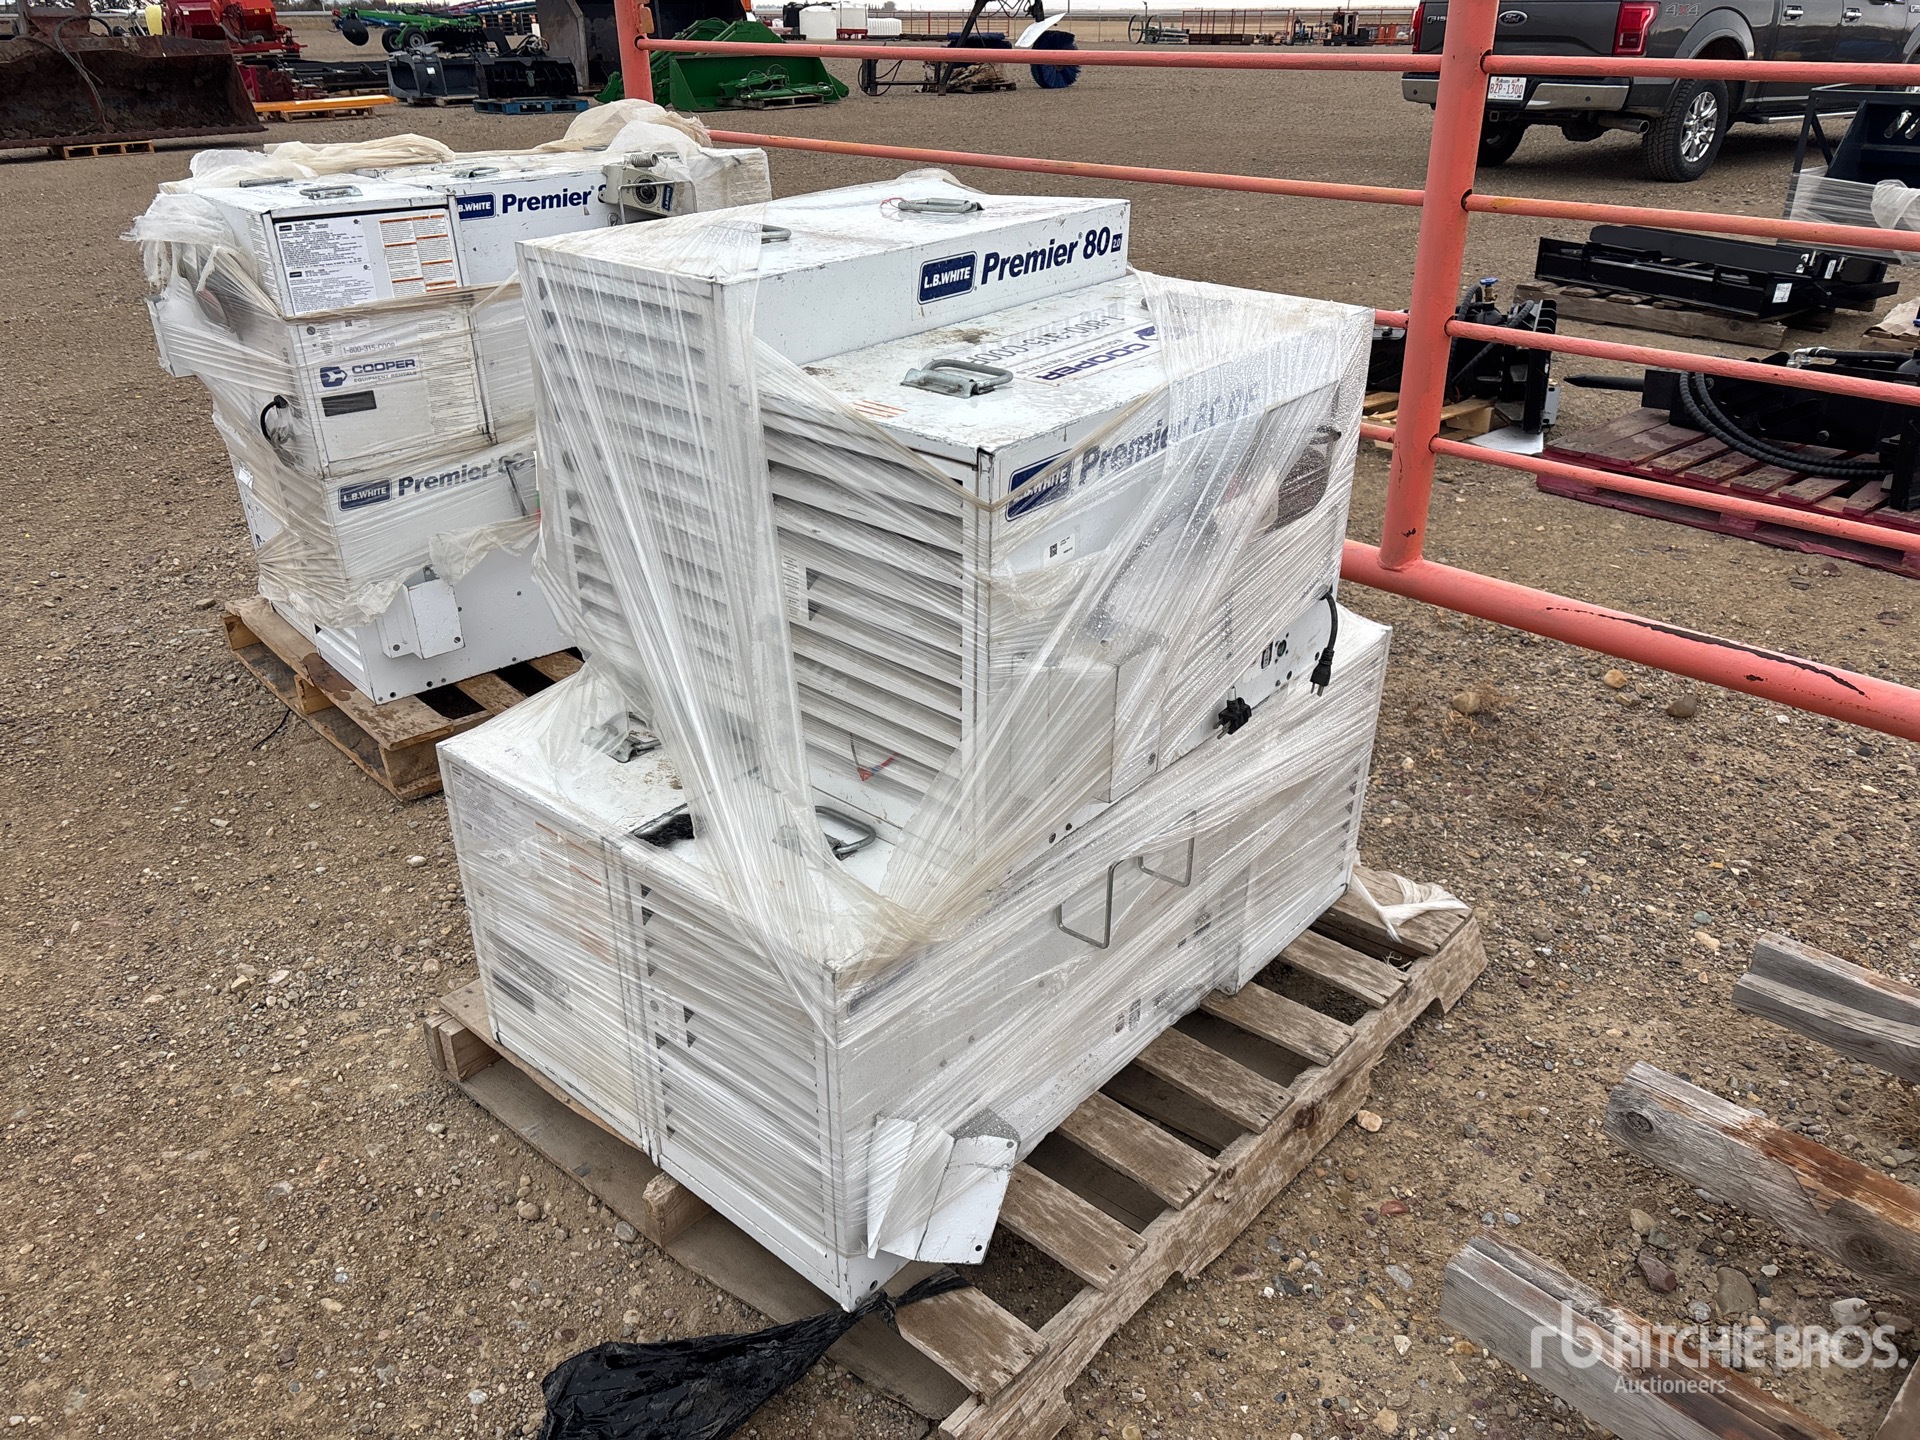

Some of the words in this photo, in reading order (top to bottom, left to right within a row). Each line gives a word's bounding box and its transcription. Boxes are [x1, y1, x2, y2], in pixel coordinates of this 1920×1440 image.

[923, 266, 971, 289] L.B.WHITE
[1083, 226, 1110, 259] 80
[351, 359, 416, 374] COOPER
[1035, 343, 1150, 380] COOPER
[353, 375, 389, 383] EQUIPMENT
[343, 486, 387, 502] L.B.WHITE
